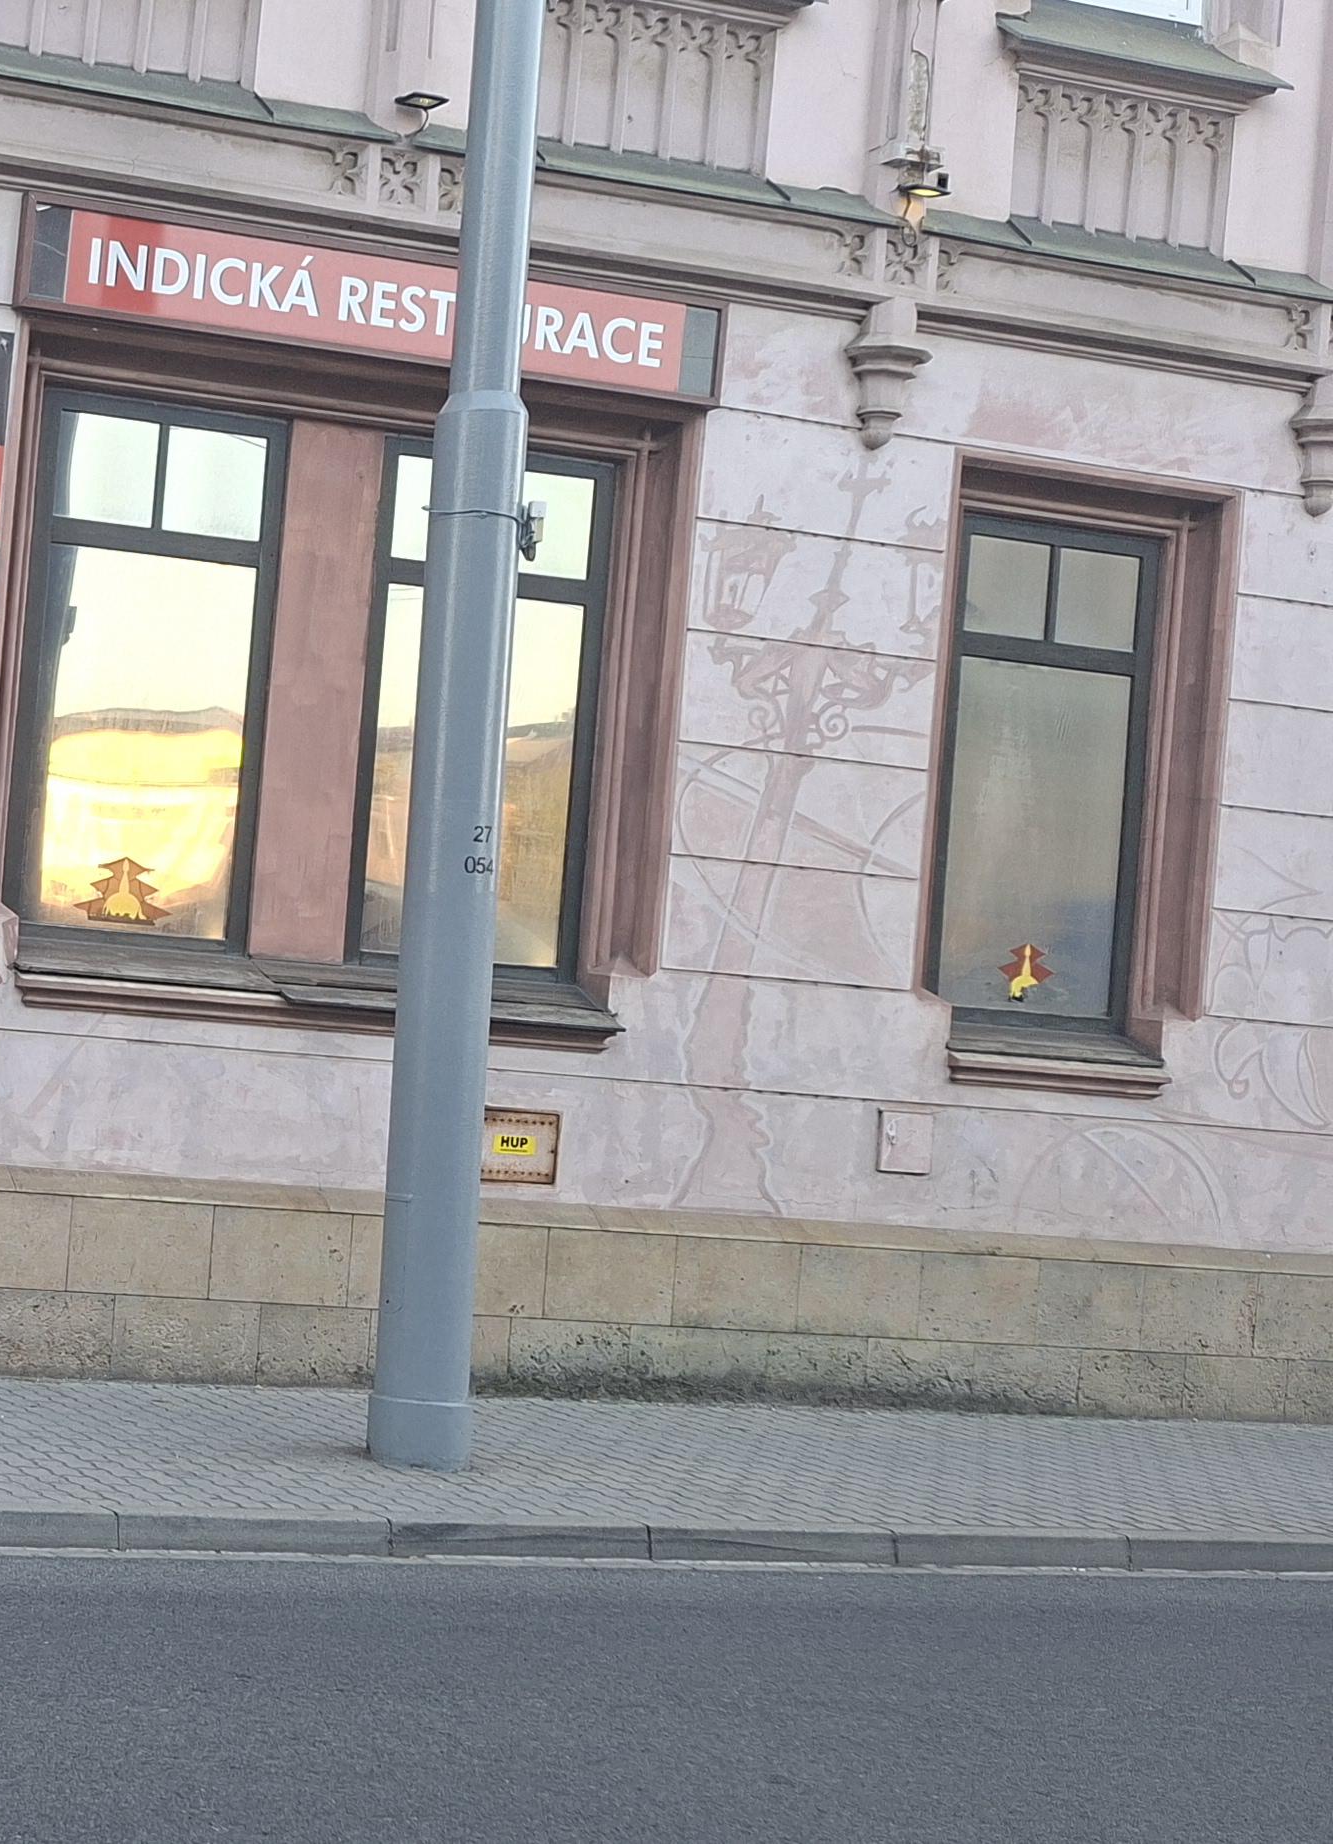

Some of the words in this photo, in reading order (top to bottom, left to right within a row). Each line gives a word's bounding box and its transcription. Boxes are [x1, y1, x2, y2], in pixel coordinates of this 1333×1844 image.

[87, 236, 319, 319] INDICKÁ
[338, 275, 665, 369] RESTRACE
[473, 825, 493, 843] 27
[500, 1135, 529, 1149] HUP
